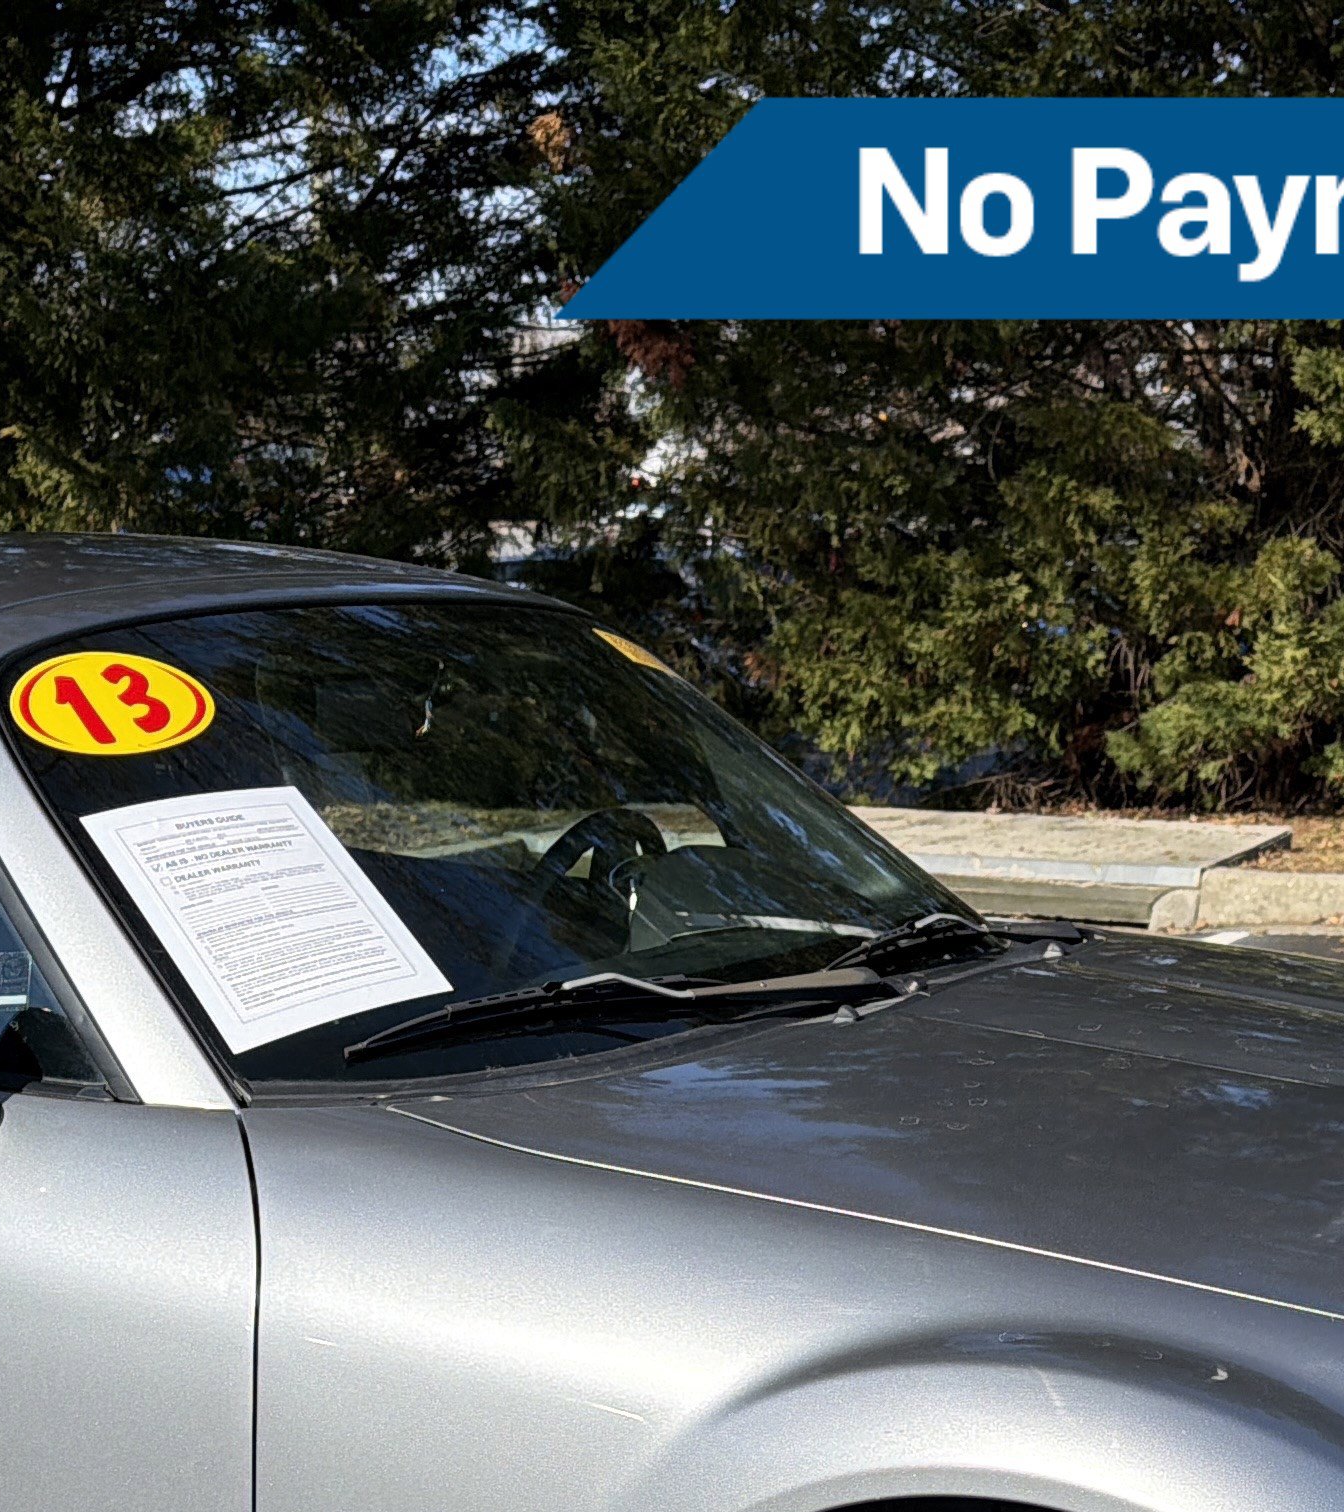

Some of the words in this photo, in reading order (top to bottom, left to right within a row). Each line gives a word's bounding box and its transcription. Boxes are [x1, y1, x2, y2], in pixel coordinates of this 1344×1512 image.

[54, 664, 171, 744] 13
[175, 817, 215, 831] BUYERS
[215, 813, 246, 825] GUIDE
[211, 845, 245, 859] DEALER
[244, 839, 293, 852] WARRANTY
[174, 869, 212, 884] DEALER
[211, 858, 261, 875] WARRANTY
